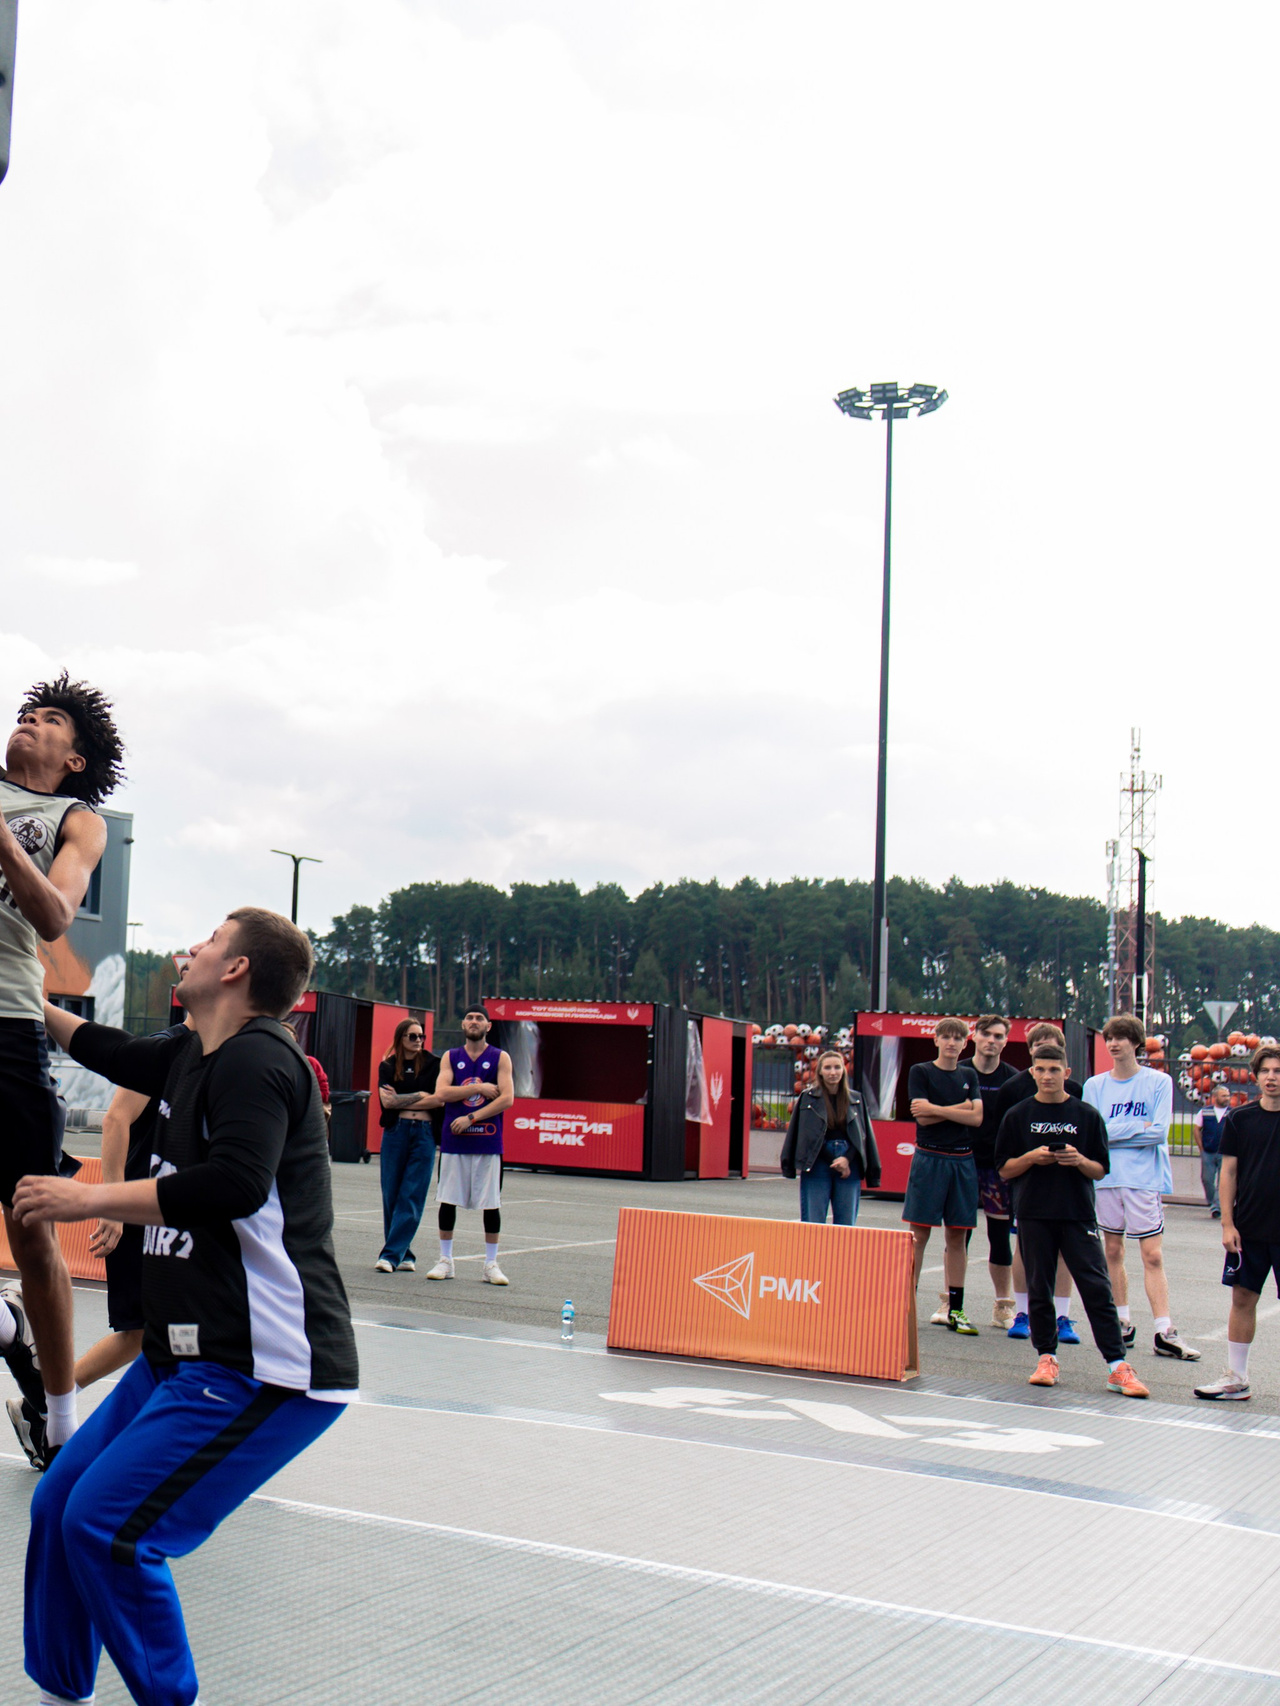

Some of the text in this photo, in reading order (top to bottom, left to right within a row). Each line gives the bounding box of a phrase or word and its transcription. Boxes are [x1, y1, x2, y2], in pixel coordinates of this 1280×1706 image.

[539, 1112, 587, 1120] ФЕСТИВАЛЬ
[513, 1117, 613, 1136] ЭНЕРГИЯ
[538, 1132, 586, 1147] РМК
